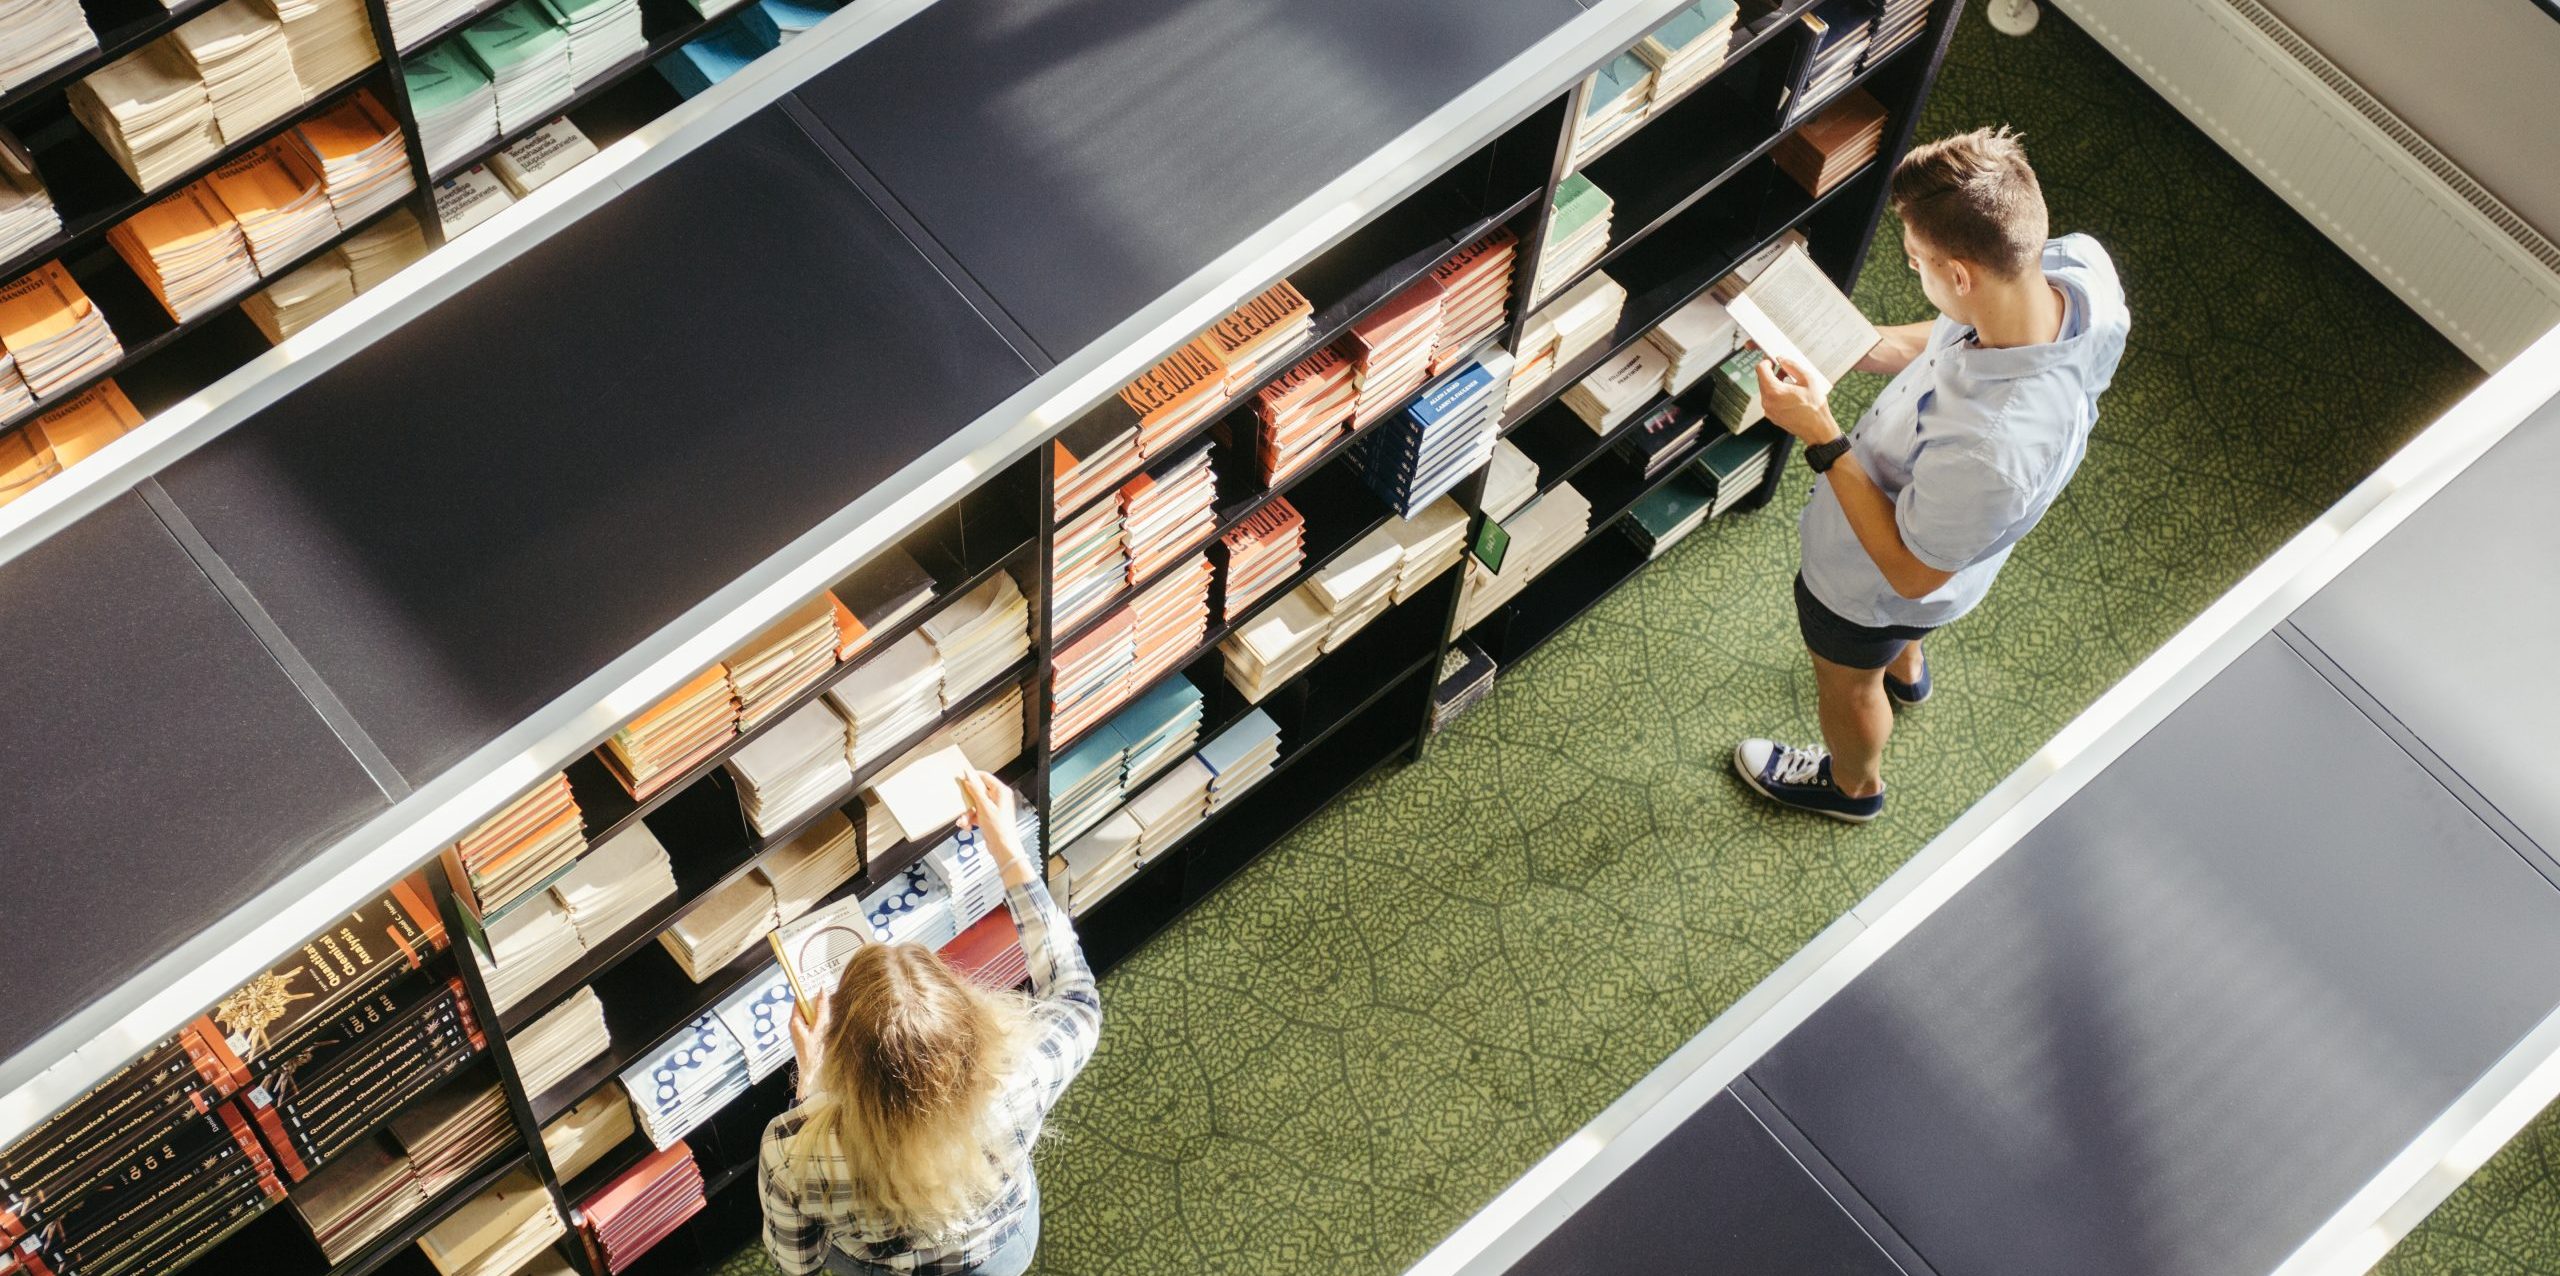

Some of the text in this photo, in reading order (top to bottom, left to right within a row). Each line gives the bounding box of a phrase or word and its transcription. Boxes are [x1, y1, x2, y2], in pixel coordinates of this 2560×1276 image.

[516, 138, 557, 163] mehaanika
[1210, 281, 1303, 352] KEEMIA
[1118, 344, 1219, 419] KEEMIA
[1429, 391, 1446, 406] ALLEN
[1435, 399, 1452, 412] LARRY
[319, 934, 357, 976] Chemical
[340, 927, 373, 966] Analysis
[399, 918, 415, 937] Daniel
[268, 1026, 317, 1061] Quantitative
[318, 1000, 355, 1027] Chemical
[356, 977, 389, 1002] Analysis
[296, 1071, 344, 1106] Quantitative
[345, 1046, 380, 1073] Chemical
[380, 1024, 412, 1048] Analysis
[301, 1084, 348, 1119] Quantitative
[349, 1059, 384, 1086] Chemical
[384, 1036, 416, 1061] Analysis
[309, 1051, 421, 1135] Quantitative Chemical Analysis
[10, 1089, 141, 1180] Quantitative Chemical Analysis
[53, 1091, 93, 1121] Chemical
[316, 1062, 426, 1147] Quantitative Chemical Analysis
[323, 1077, 434, 1158] Quantitative Chemical Analysis
[20, 1108, 153, 1195] Quantitative Chemical Analysis
[42, 1124, 172, 1213] Quantitative Chemical Analysis
[64, 1219, 116, 1255] Quantitative
[118, 1194, 156, 1221] Chemical
[157, 1172, 192, 1196] Analysis
[146, 1241, 185, 1268] Chemical
[186, 1220, 218, 1243] Analysis
